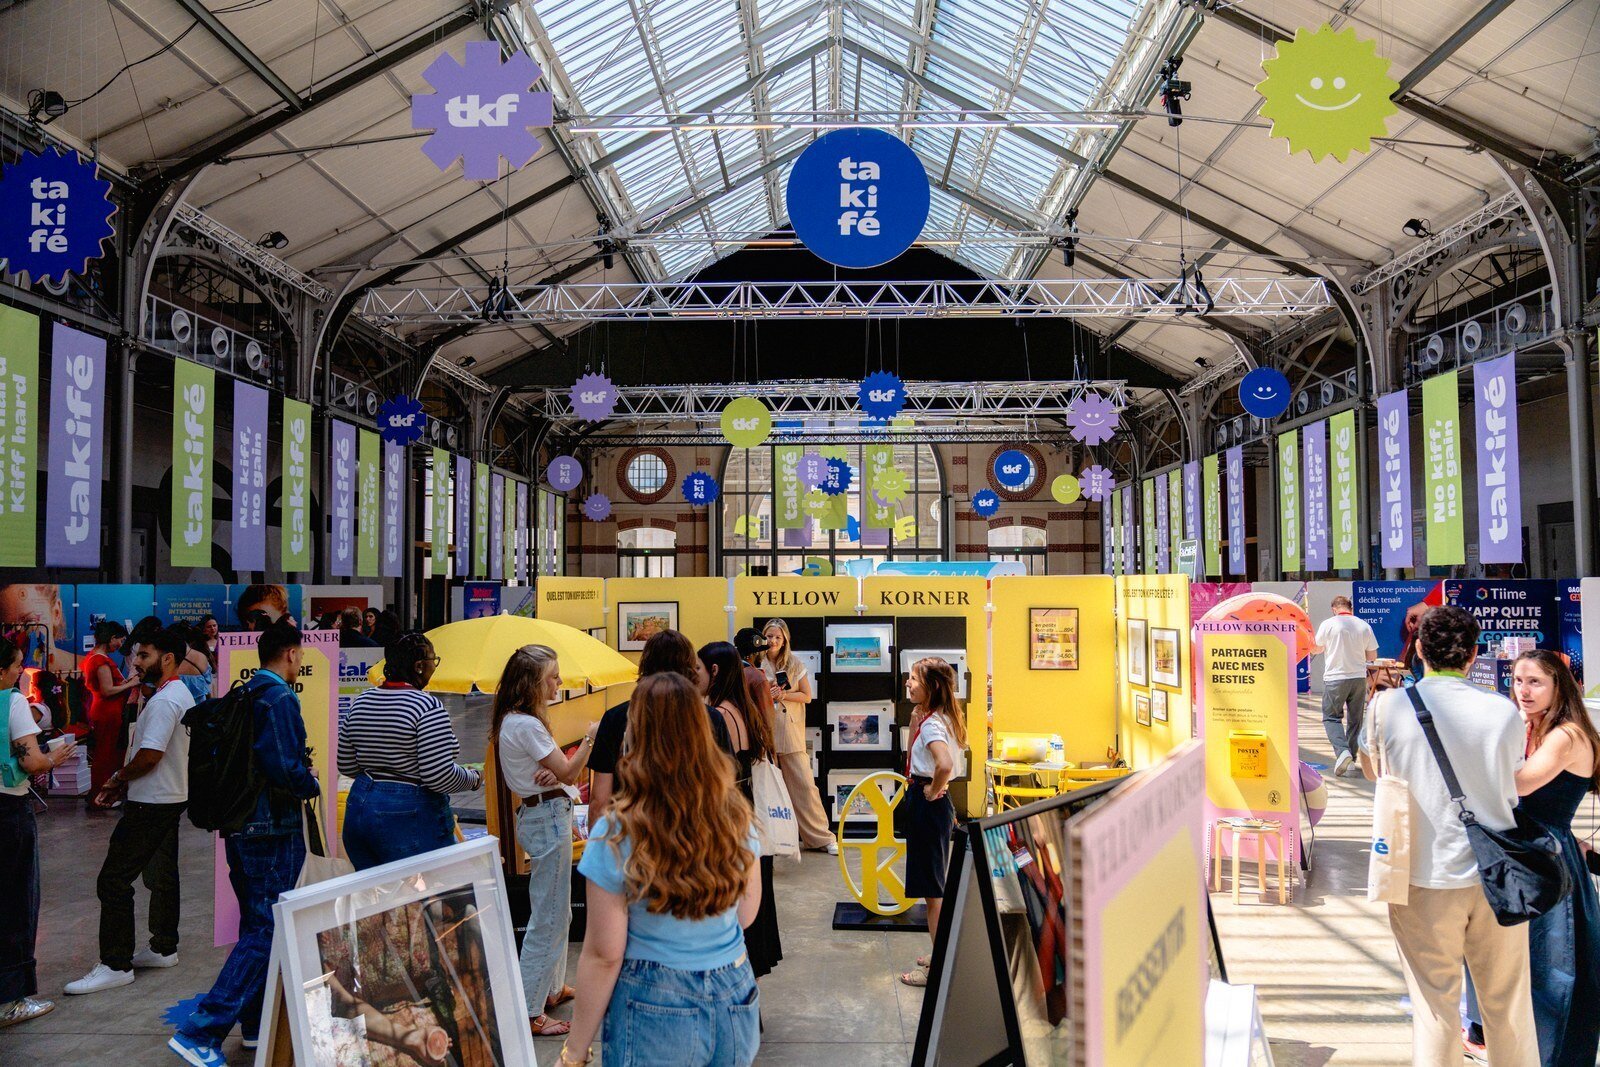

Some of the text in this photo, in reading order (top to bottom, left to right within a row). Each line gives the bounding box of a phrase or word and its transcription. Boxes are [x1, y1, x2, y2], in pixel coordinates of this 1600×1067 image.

[445, 94, 520, 127] tkf
[838, 156, 880, 180] ta
[30, 176, 68, 199] ta
[840, 183, 878, 208] ki
[31, 202, 66, 226] ki
[838, 210, 880, 236] fé
[28, 228, 68, 252] fé
[580, 391, 607, 404] tkf
[869, 389, 896, 402] tkf
[388, 413, 415, 427] tkf
[731, 417, 760, 431] tkf
[11, 374, 27, 513] Kiff hard
[64, 354, 94, 545] takifé
[183, 384, 205, 547] takifé
[1002, 464, 1022, 474] tkf
[1429, 420, 1446, 523] No kiff,
[1443, 420, 1457, 516] no gain
[1483, 375, 1509, 544] takifé
[240, 426, 251, 528] No kiff,
[252, 432, 264, 525] no gain
[290, 418, 306, 555] takifé
[782, 452, 797, 520] takifé
[1383, 408, 1404, 551] takifé
[336, 437, 349, 561] takifé
[1282, 444, 1296, 558] takifé
[1336, 426, 1352, 554] takifé
[387, 453, 399, 564] takifé
[978, 499, 994, 507] tkf
[1230, 458, 1241, 563] takifé
[753, 591, 970, 606] YELLOW KORNER
[1395, 586, 1425, 594] prochain
[1490, 588, 1527, 600] Tiime
[1502, 607, 1524, 618] QUI
[1526, 607, 1541, 617] TE
[1245, 624, 1296, 632] KORNER
[1496, 620, 1539, 630] KIFFER
[1212, 648, 1267, 658] PARTAGER
[1212, 662, 1265, 671] AVEC MES
[1212, 675, 1255, 684] BESTIES
